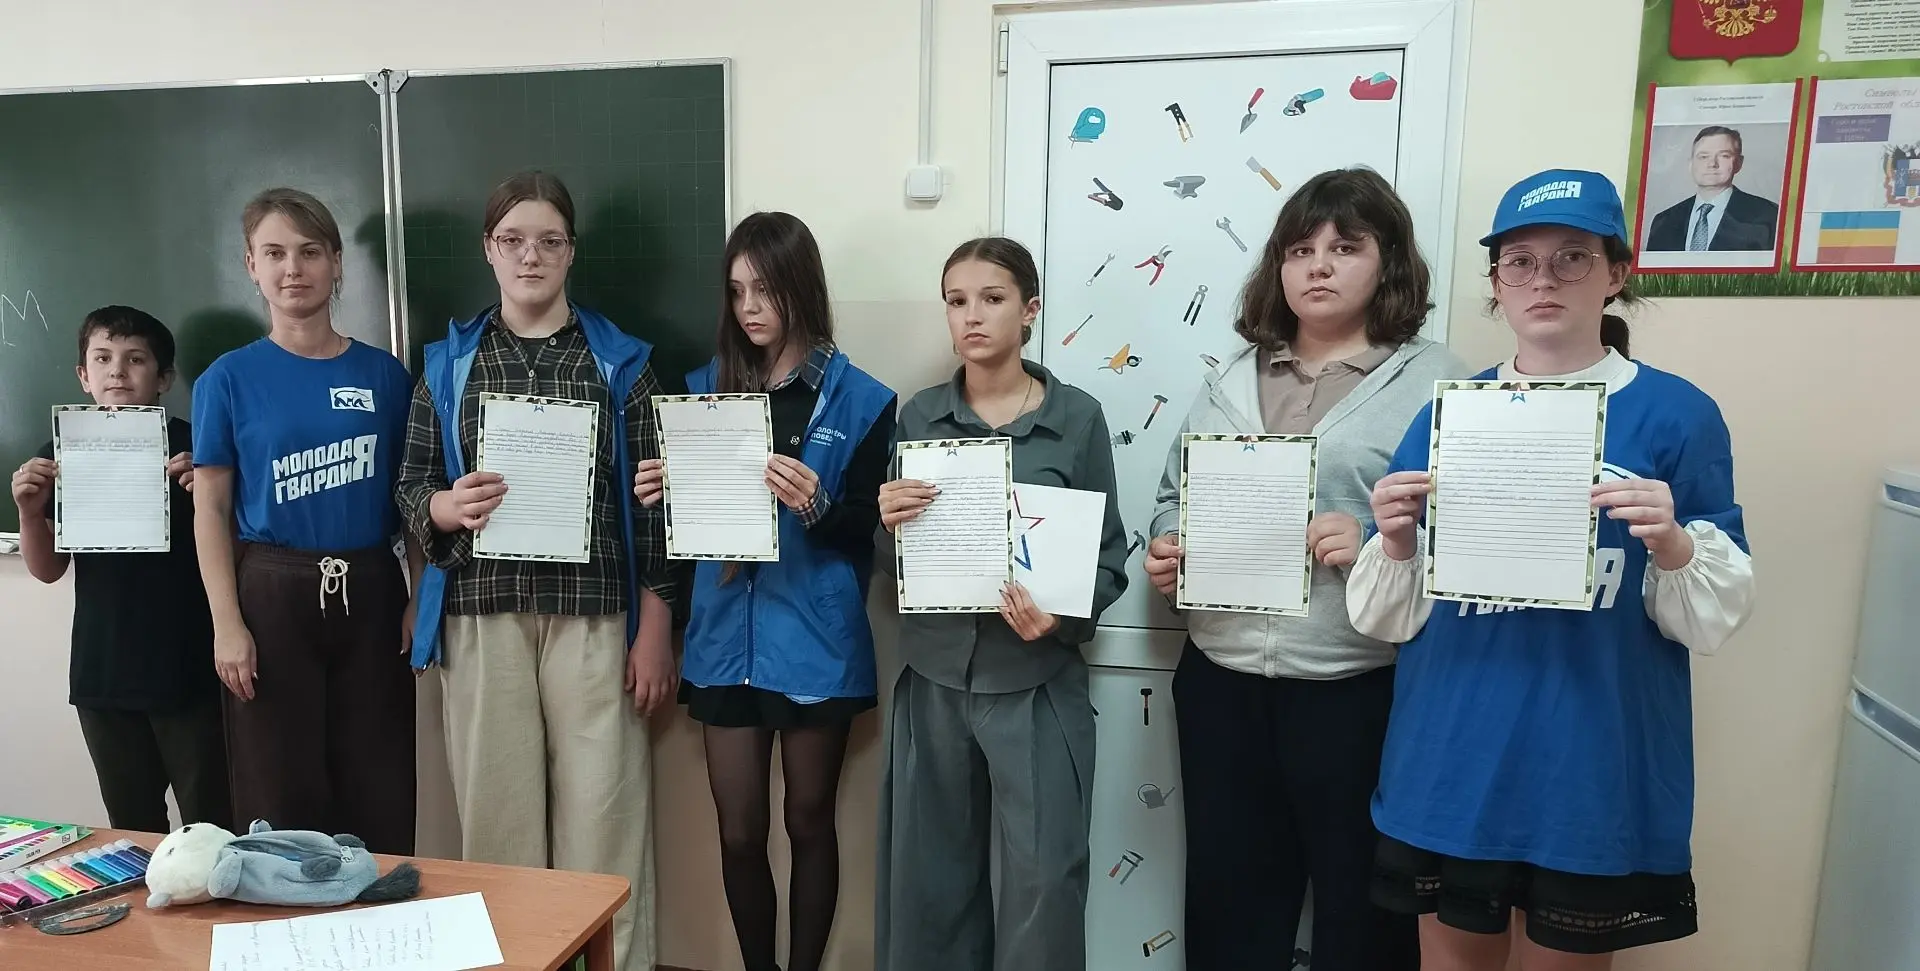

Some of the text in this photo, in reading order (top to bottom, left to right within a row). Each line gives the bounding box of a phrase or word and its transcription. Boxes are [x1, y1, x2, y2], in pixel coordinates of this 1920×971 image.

[1518, 186, 1580, 212] ГВАРДИЯ
[1520, 181, 1581, 203] МОЛОДАЯ
[272, 434, 377, 480] МОЛОДАЯ
[275, 448, 376, 504] ГВАРДИЯ
